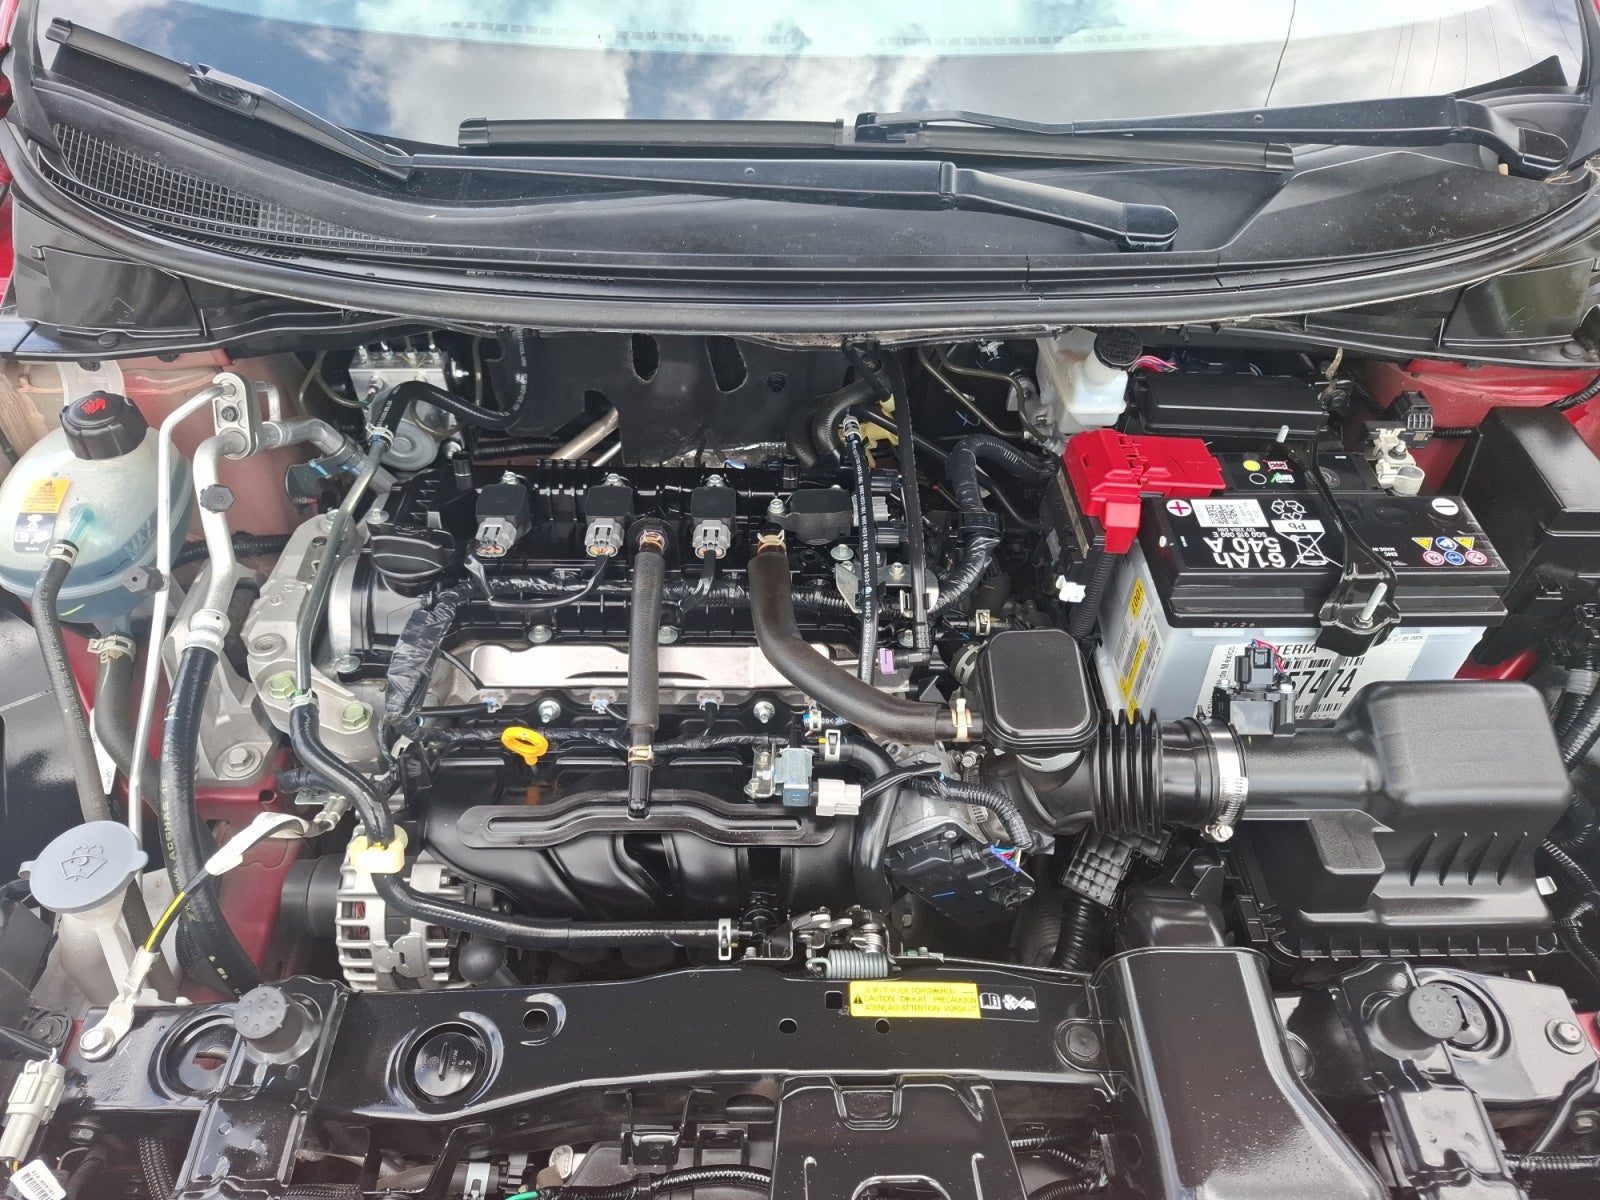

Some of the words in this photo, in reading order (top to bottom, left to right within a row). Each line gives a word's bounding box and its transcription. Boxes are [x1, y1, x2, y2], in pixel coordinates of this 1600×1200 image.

[1289, 522, 1307, 531] Pb
[124, 519, 156, 561] MAX
[1203, 537, 1223, 553] A
[1231, 537, 1281, 553] 540
[1213, 553, 1286, 568] 61Ah
[1275, 644, 1317, 656] TERIA
